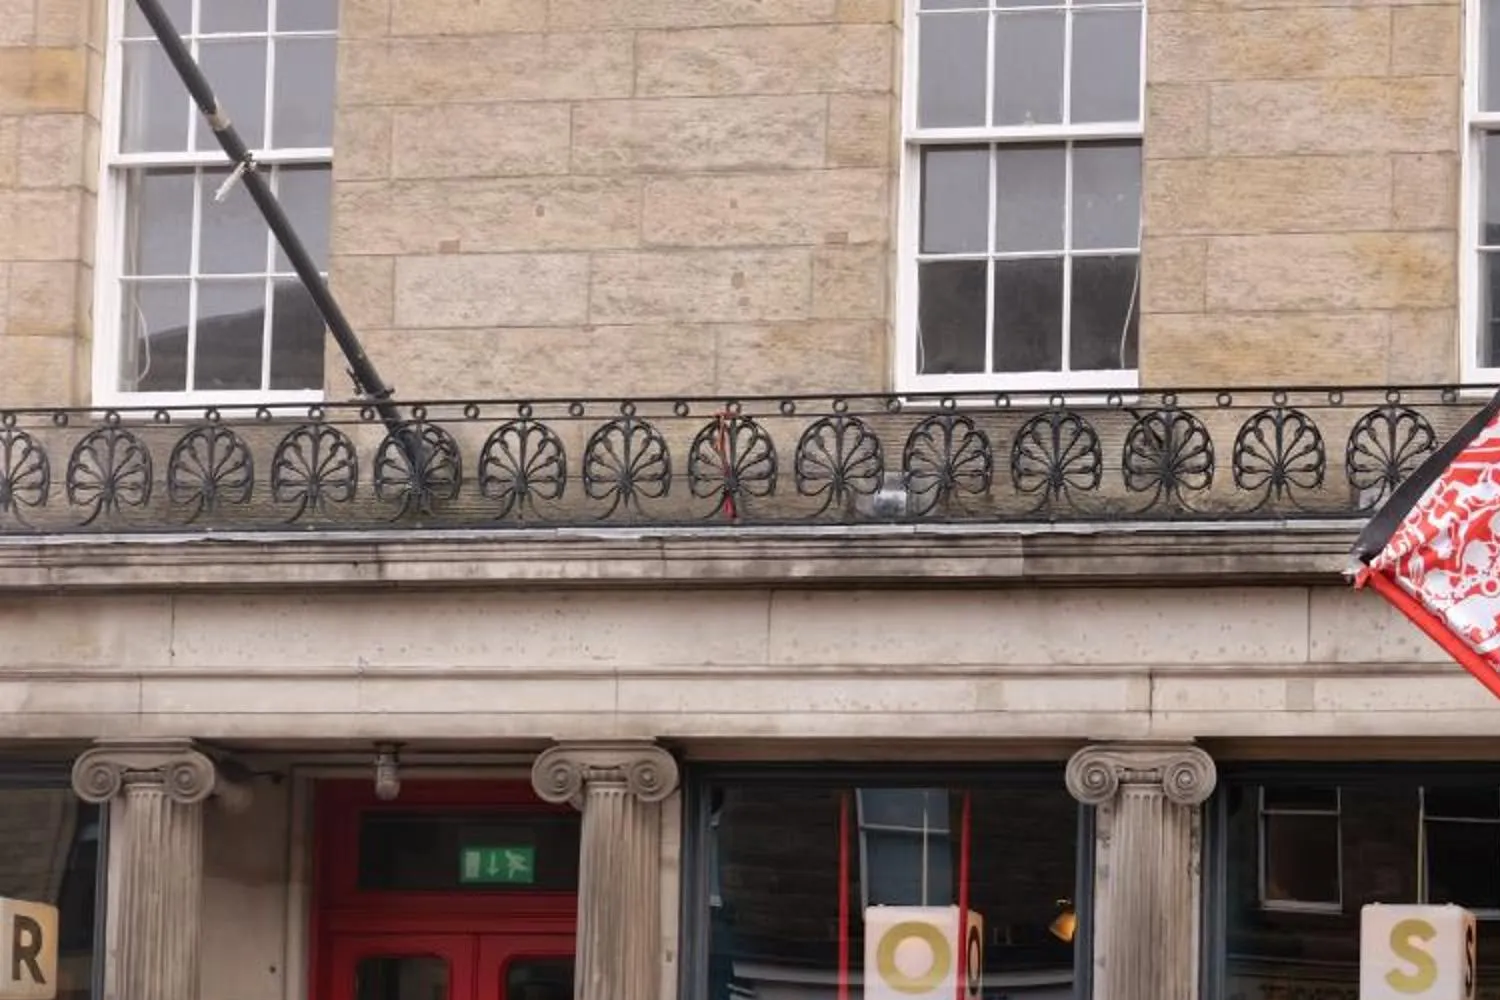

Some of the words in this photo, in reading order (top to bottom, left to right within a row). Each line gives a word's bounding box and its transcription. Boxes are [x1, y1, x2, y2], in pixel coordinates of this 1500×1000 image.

[11, 913, 47, 985] R
[876, 921, 951, 994] O
[1385, 918, 1438, 994] S
